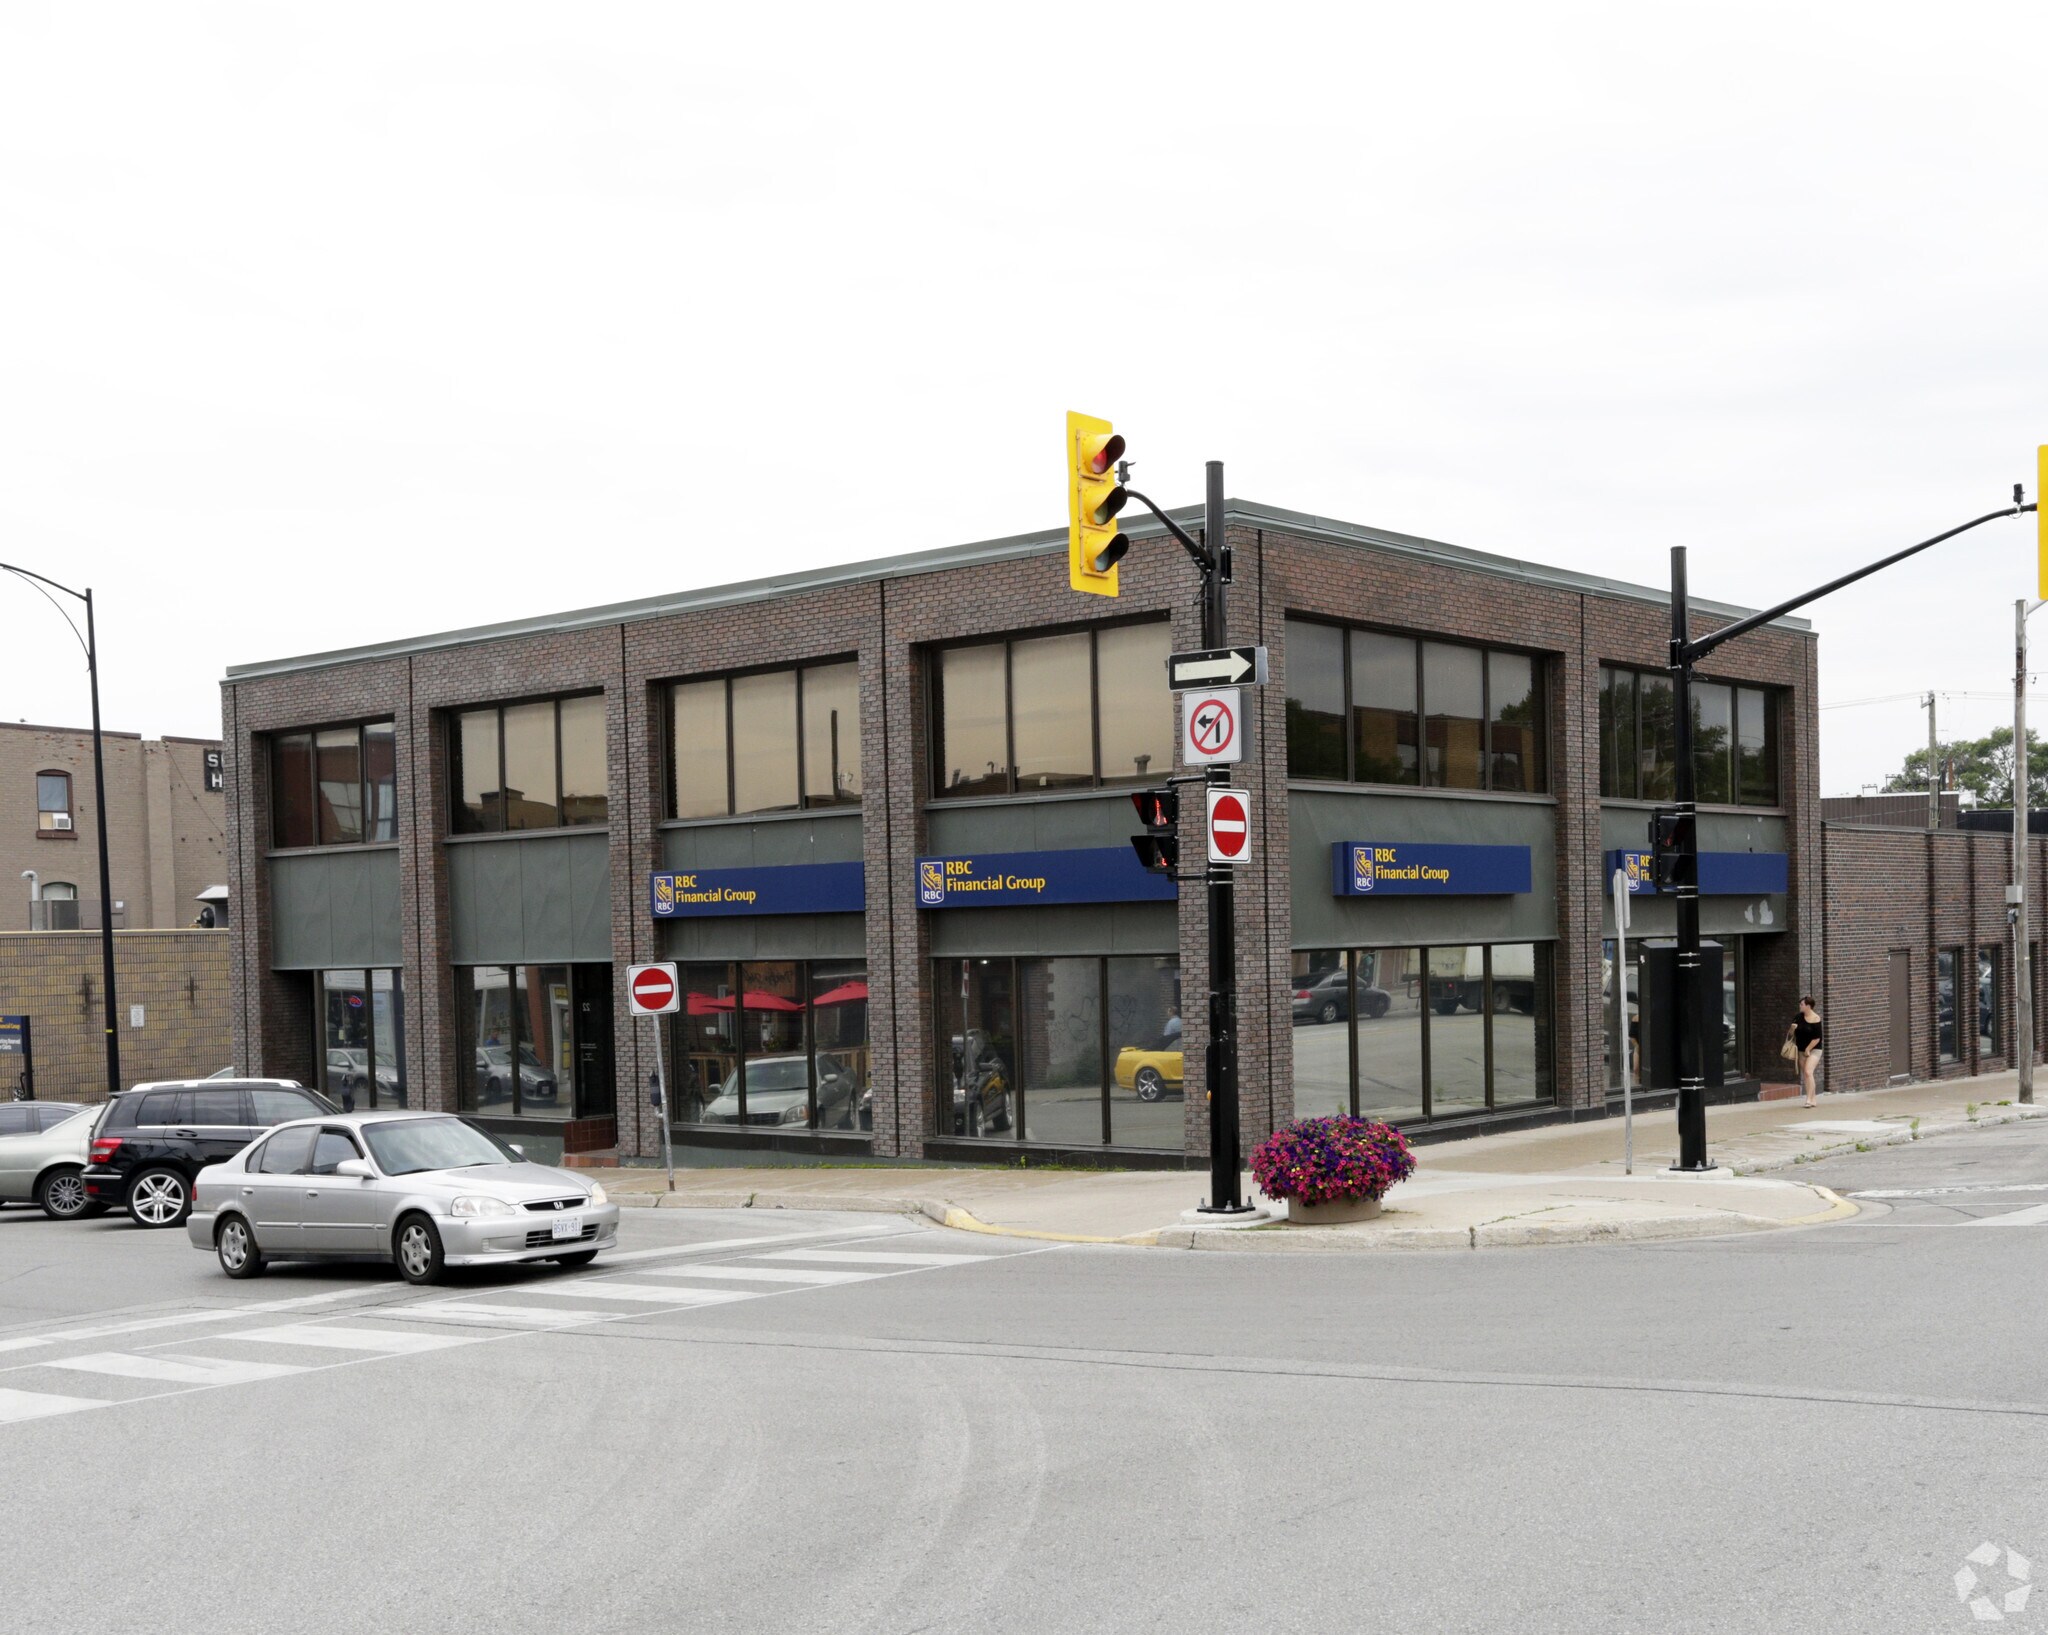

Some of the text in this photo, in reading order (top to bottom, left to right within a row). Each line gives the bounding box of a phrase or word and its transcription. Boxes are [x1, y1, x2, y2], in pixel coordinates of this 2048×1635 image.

[207, 752, 224, 768] S
[1375, 848, 1397, 863] RBC
[945, 860, 973, 875] RBC
[1375, 864, 1450, 884] Financial Group
[675, 875, 697, 888] RBC
[946, 874, 1046, 893] Financial Group
[1356, 877, 1371, 887] RBC
[675, 888, 756, 905] Financial Group
[924, 890, 941, 900] RBC
[657, 902, 672, 911] RBC
